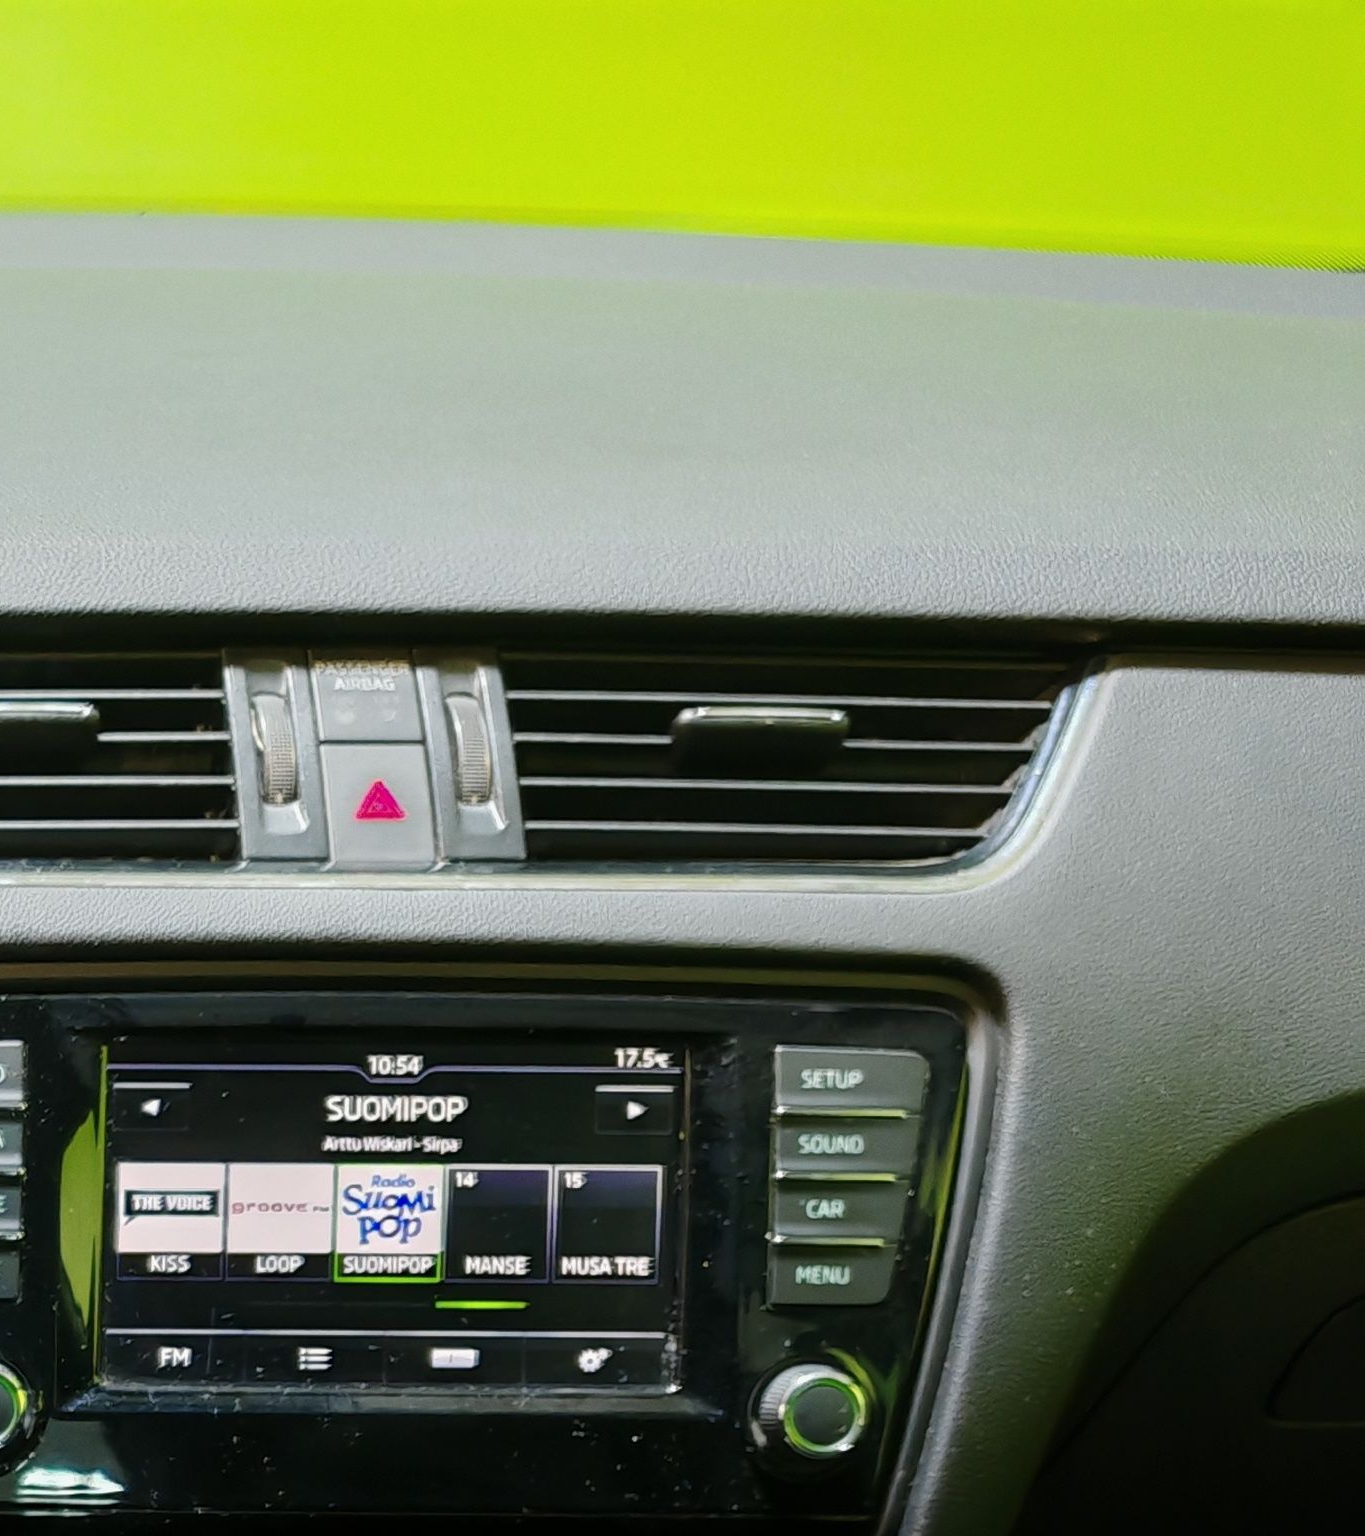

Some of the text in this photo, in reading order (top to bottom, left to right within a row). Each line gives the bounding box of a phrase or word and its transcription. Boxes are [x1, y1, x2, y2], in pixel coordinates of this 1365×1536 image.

[334, 676, 396, 691] AIRBAG
[367, 1055, 423, 1075] 10:54
[801, 1069, 863, 1089] SETUP
[325, 1095, 468, 1122] SUOMIPOP
[798, 1134, 865, 1154] SOUND
[371, 1174, 416, 1189] Radio
[455, 1172, 477, 1188] 14
[564, 1172, 587, 1189] 15
[131, 1194, 213, 1211] THE VOICE
[805, 1200, 845, 1219] CAR
[147, 1255, 191, 1273] KISS
[255, 1255, 305, 1273] LOOP
[343, 1256, 436, 1274] SUOMIPOP
[465, 1256, 530, 1275] MANSE
[561, 1256, 654, 1276] MUSA TRE
[796, 1266, 850, 1285] MENU
[158, 1346, 192, 1369] FM
